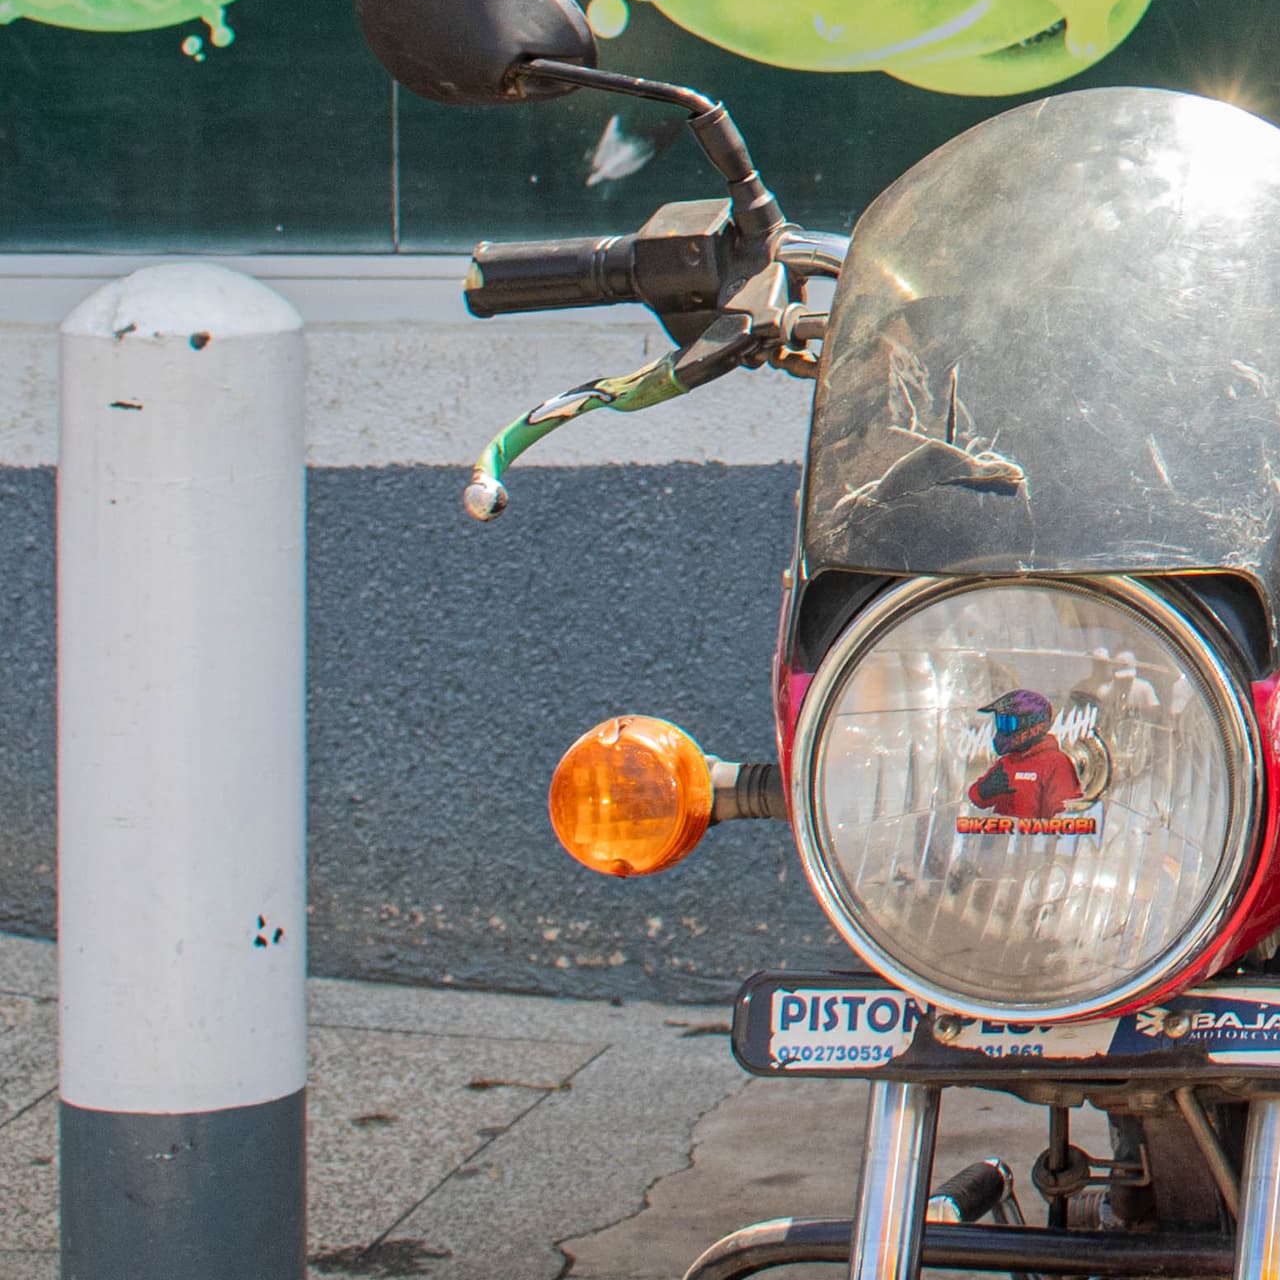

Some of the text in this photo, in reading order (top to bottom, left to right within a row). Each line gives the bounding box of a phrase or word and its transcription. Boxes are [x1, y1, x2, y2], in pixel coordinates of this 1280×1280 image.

[956, 815, 1097, 835] BIKER NAIROBI
[778, 1044, 894, 1063] 0702730534
